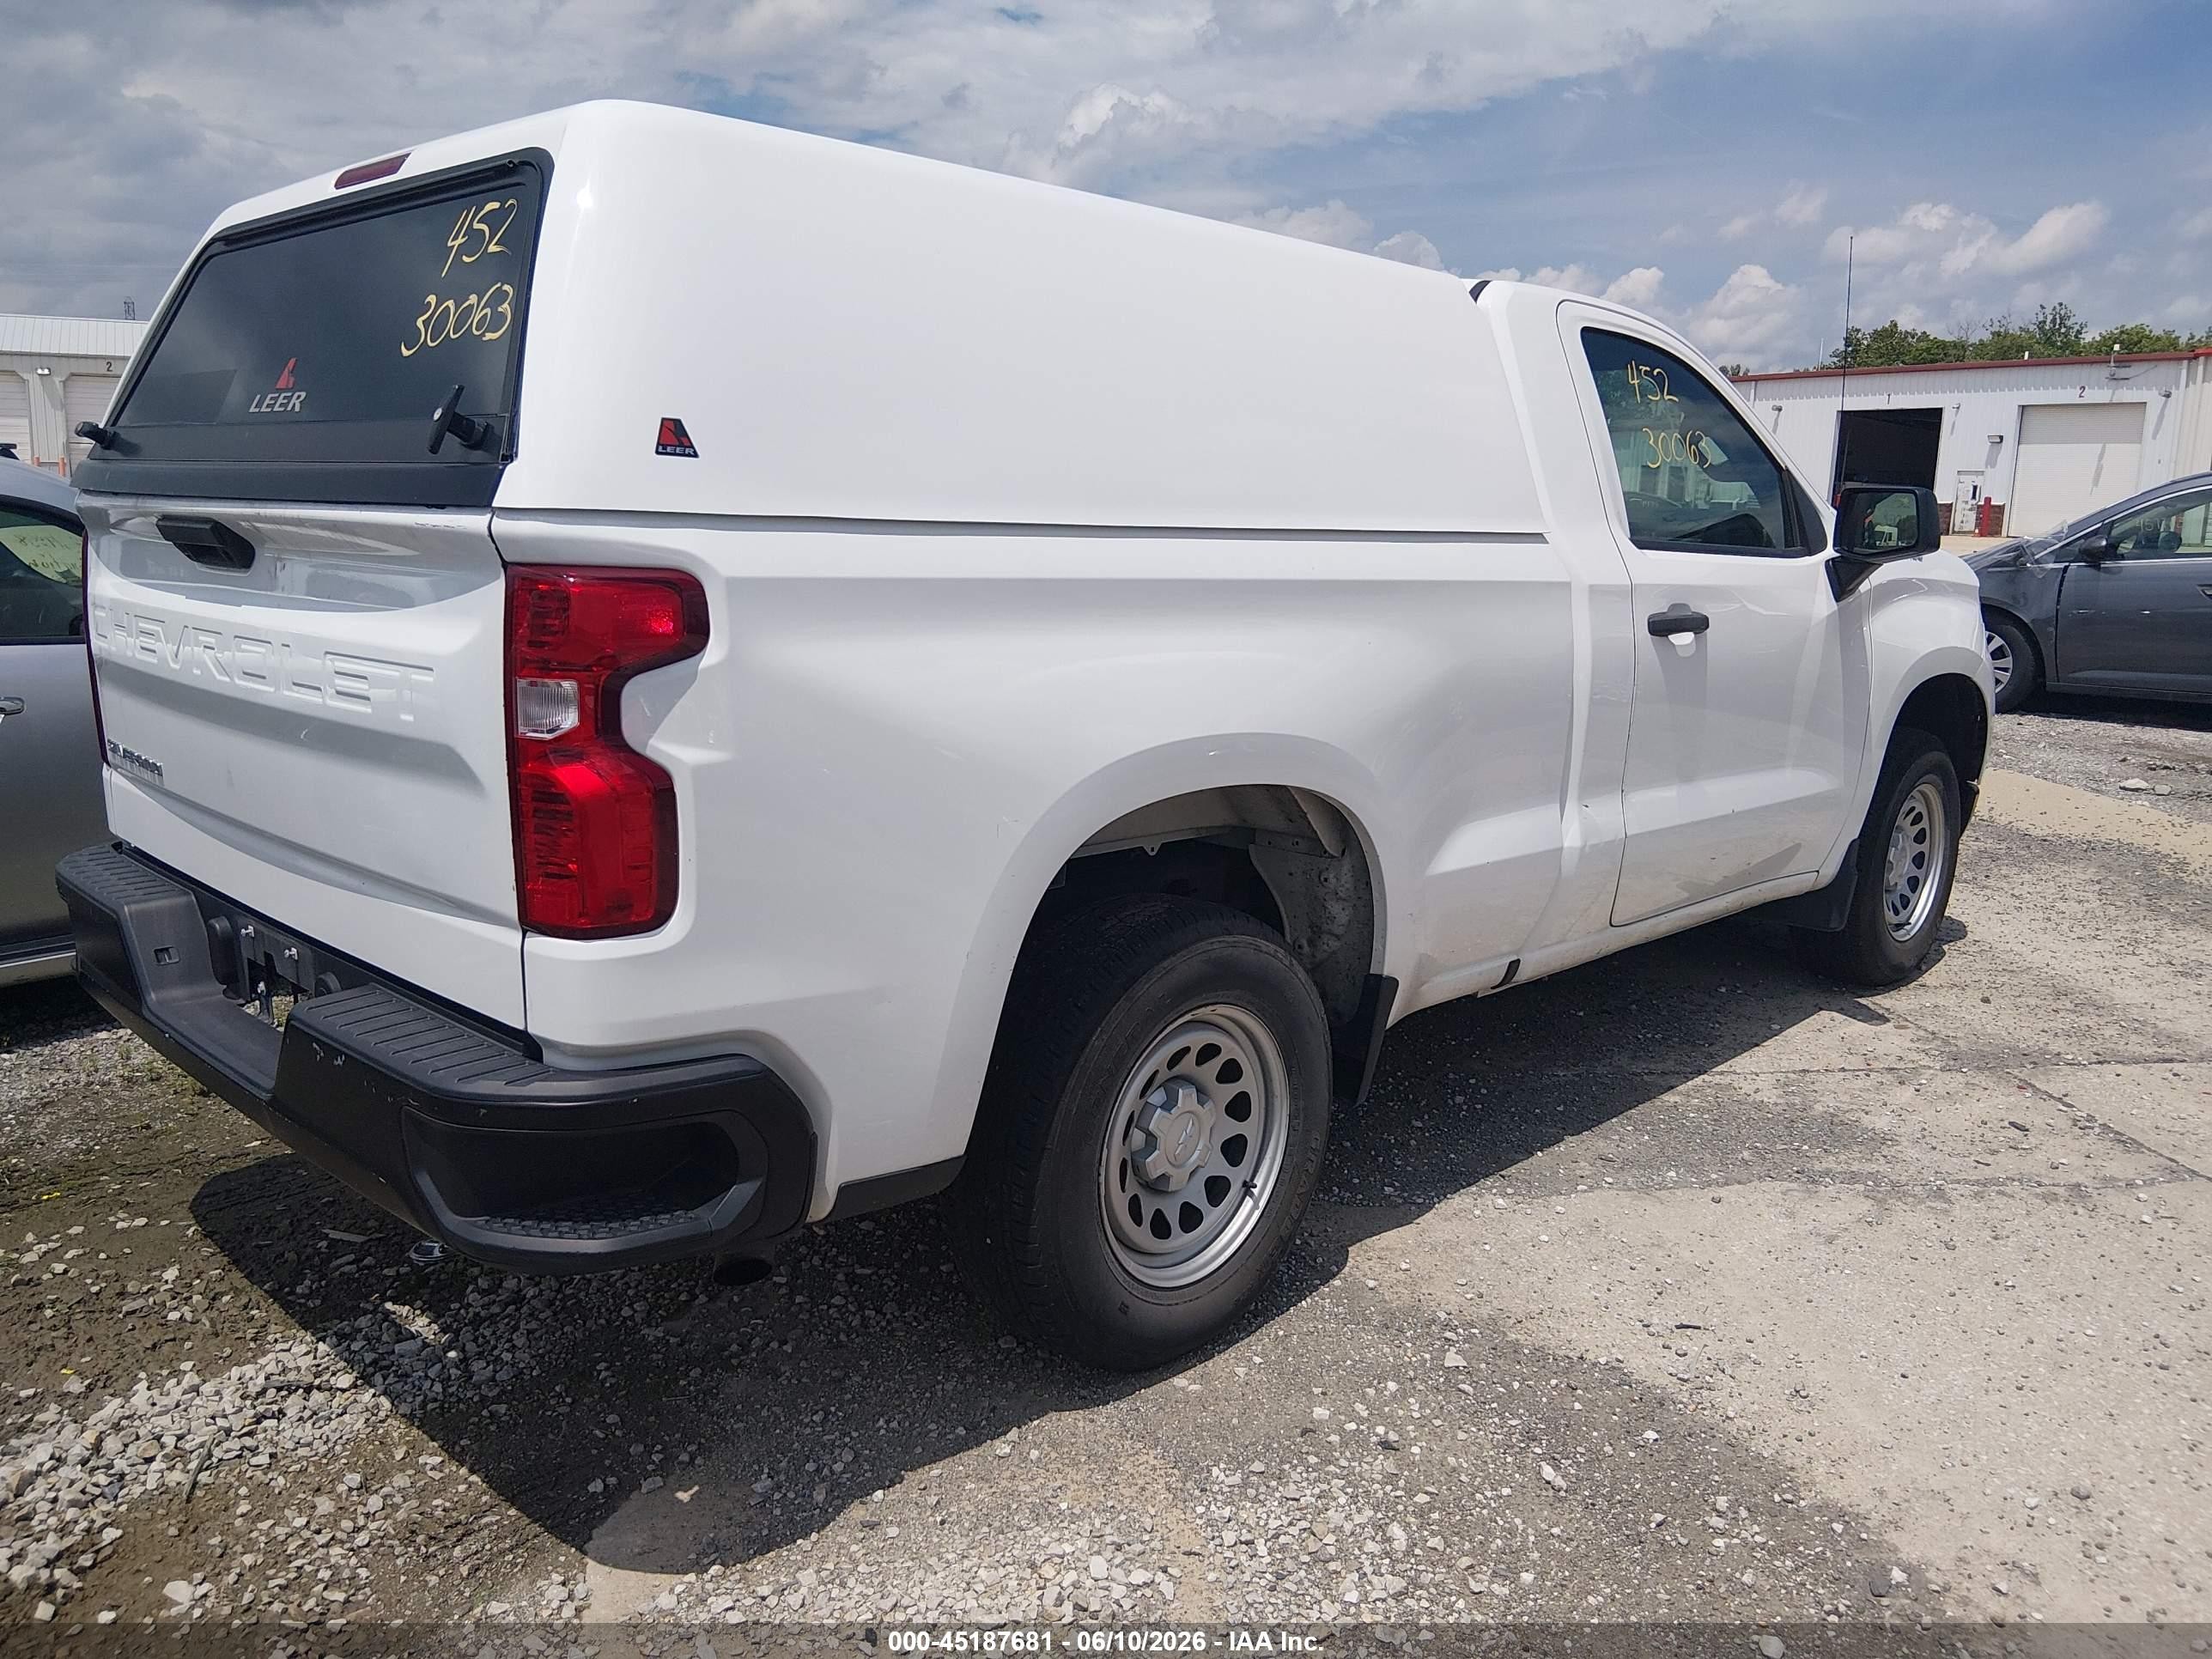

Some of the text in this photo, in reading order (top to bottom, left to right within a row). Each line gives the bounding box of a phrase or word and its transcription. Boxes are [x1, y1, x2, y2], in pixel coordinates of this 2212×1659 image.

[441, 198, 519, 279] 452
[400, 282, 514, 357] 30063
[106, 361, 113, 372] 2
[1627, 360, 1680, 404] 452
[248, 391, 307, 413] LEER
[2078, 386, 2086, 398] 2
[658, 445, 696, 455] LEER
[1642, 428, 1711, 469] 30063
[92, 605, 434, 722] CHEVROLET
